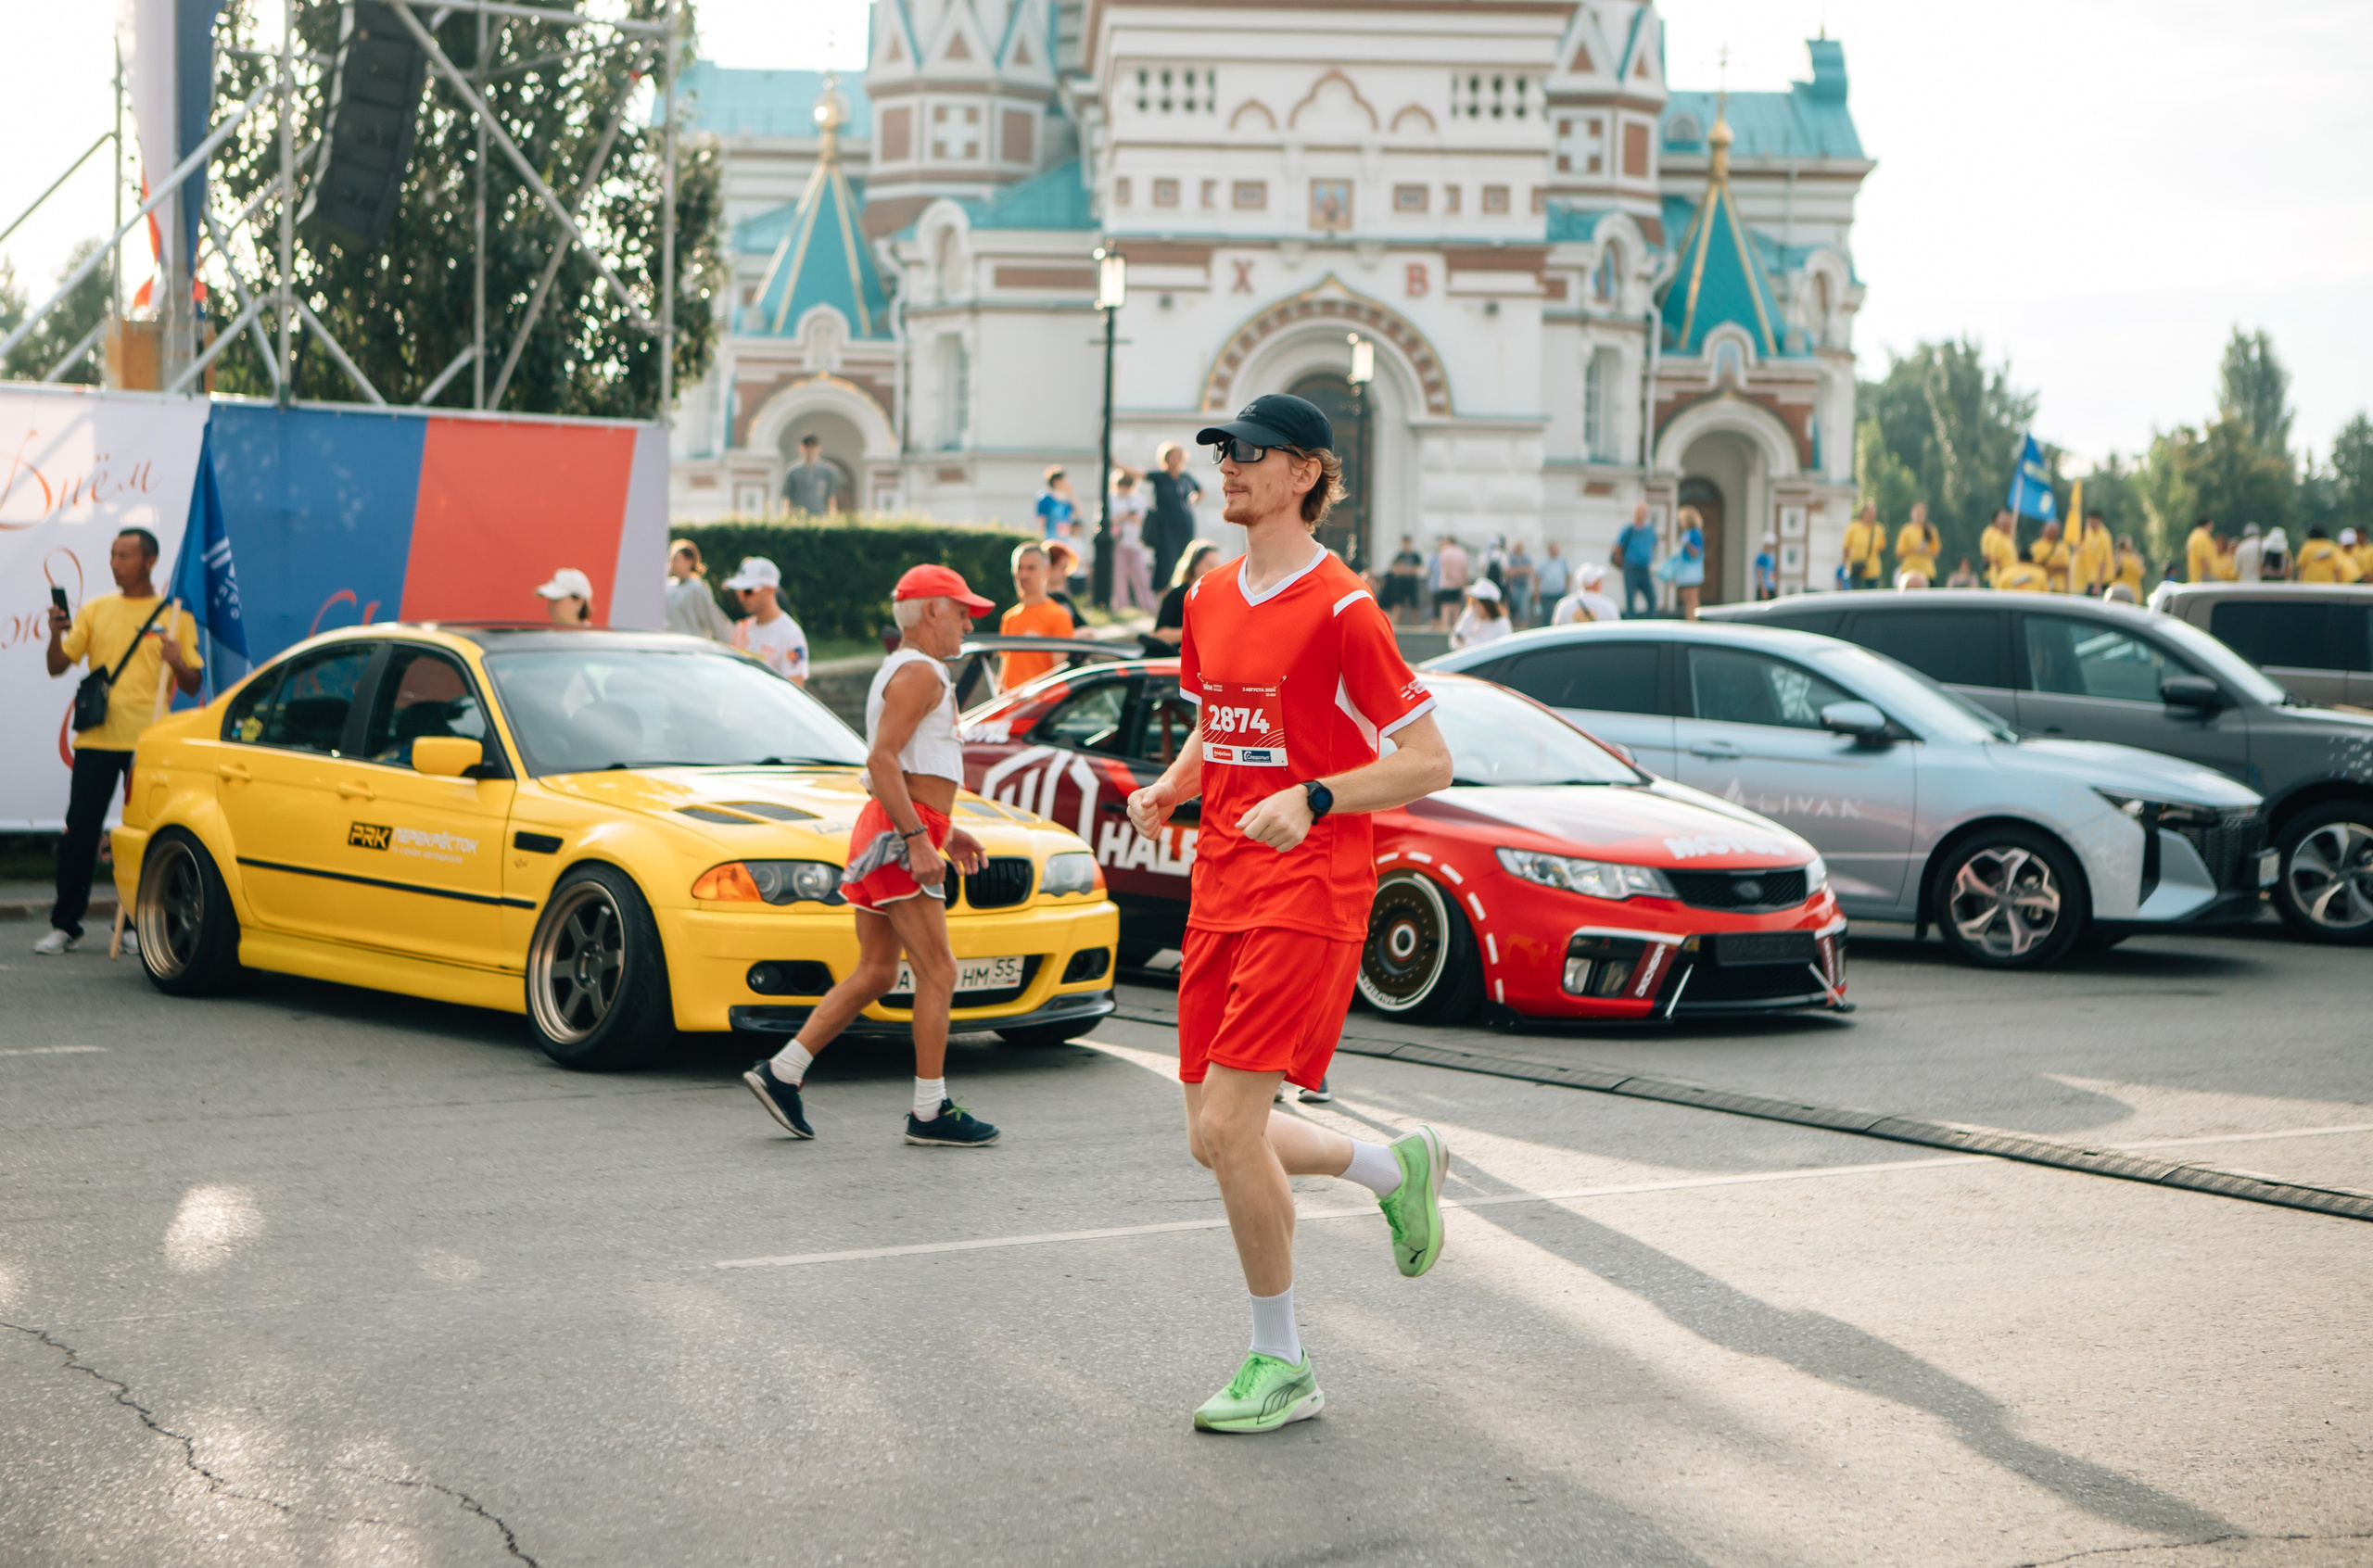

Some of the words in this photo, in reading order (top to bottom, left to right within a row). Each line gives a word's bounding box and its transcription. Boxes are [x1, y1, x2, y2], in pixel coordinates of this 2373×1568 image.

[1208, 704, 1270, 734] 2874
[1759, 792, 1862, 819] LIVAN
[350, 824, 389, 849] PRK
[994, 957, 1018, 979] 55
